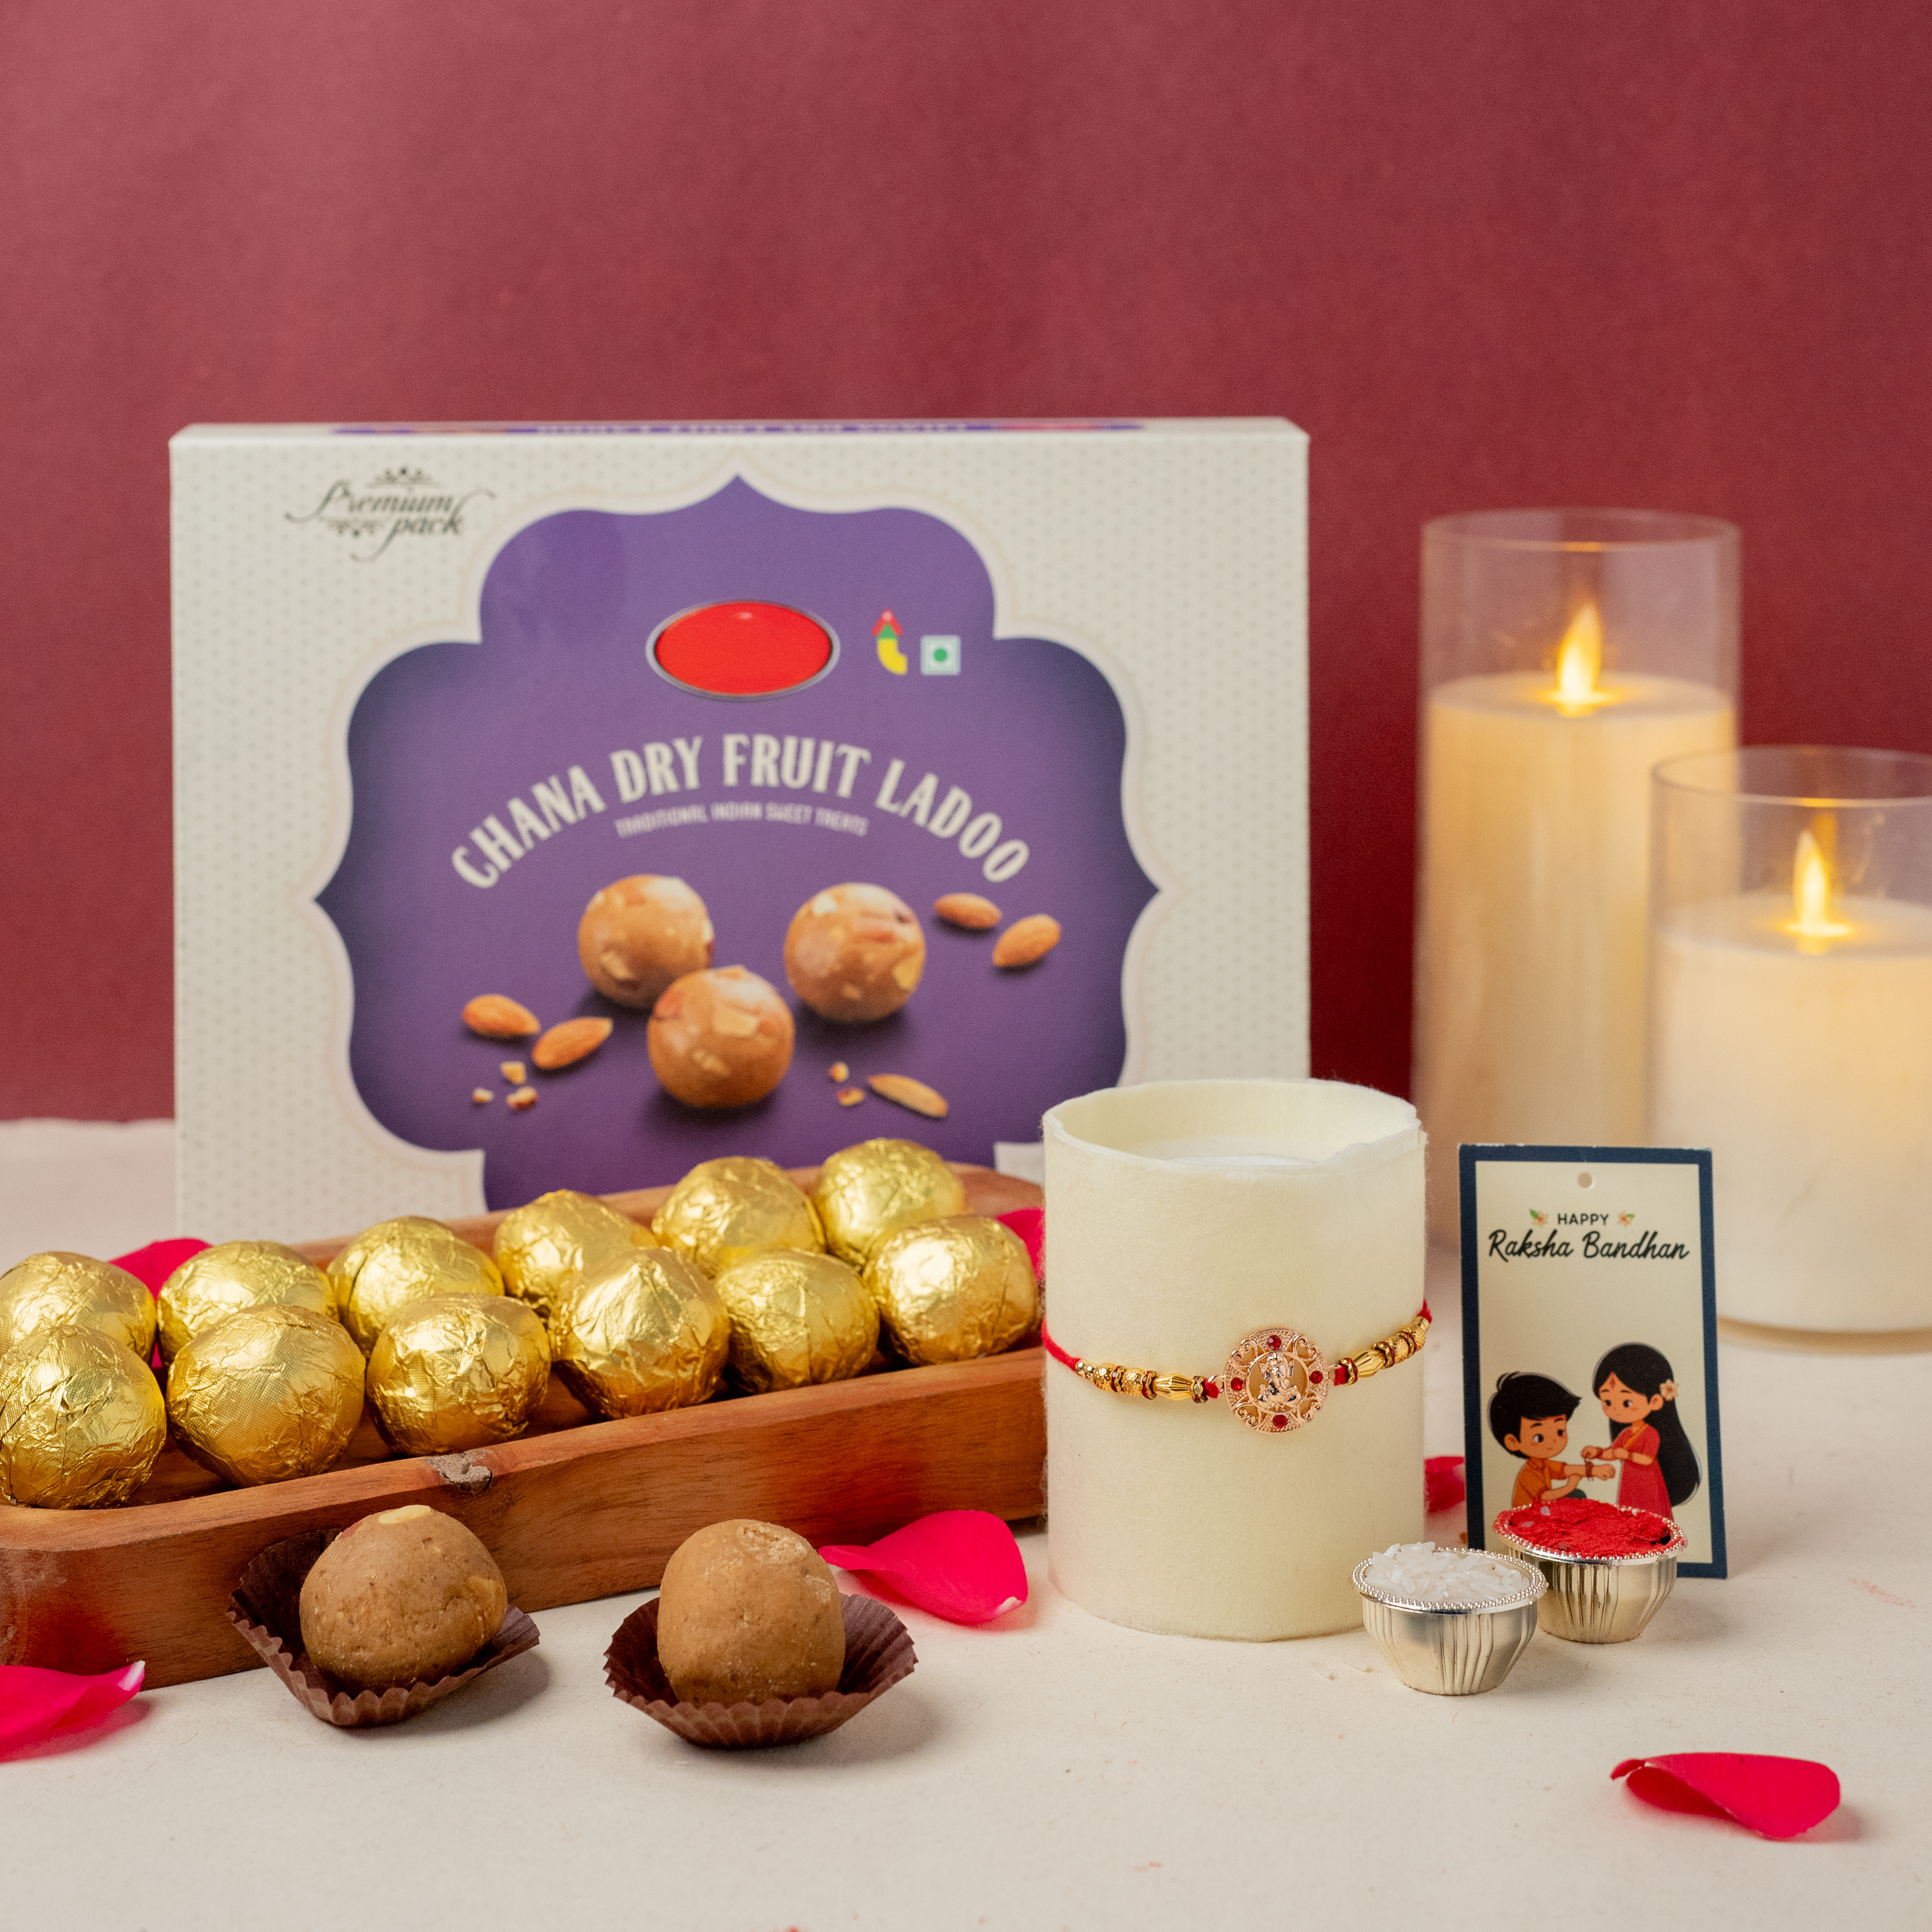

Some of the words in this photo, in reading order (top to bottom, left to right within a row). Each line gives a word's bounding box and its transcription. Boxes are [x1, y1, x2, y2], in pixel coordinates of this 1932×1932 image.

[284, 479, 454, 524] Premium
[451, 764, 607, 890] CHANA
[609, 735, 705, 804] DRY
[722, 733, 872, 799] FRUIT
[874, 757, 1030, 884] LADOO
[614, 803, 708, 838] TRADITIONAL
[764, 802, 813, 825] SWEET
[1557, 1213, 1609, 1226] HAPPY
[1488, 1229, 1575, 1262] Raksha
[1582, 1229, 1690, 1260] Bandhan
